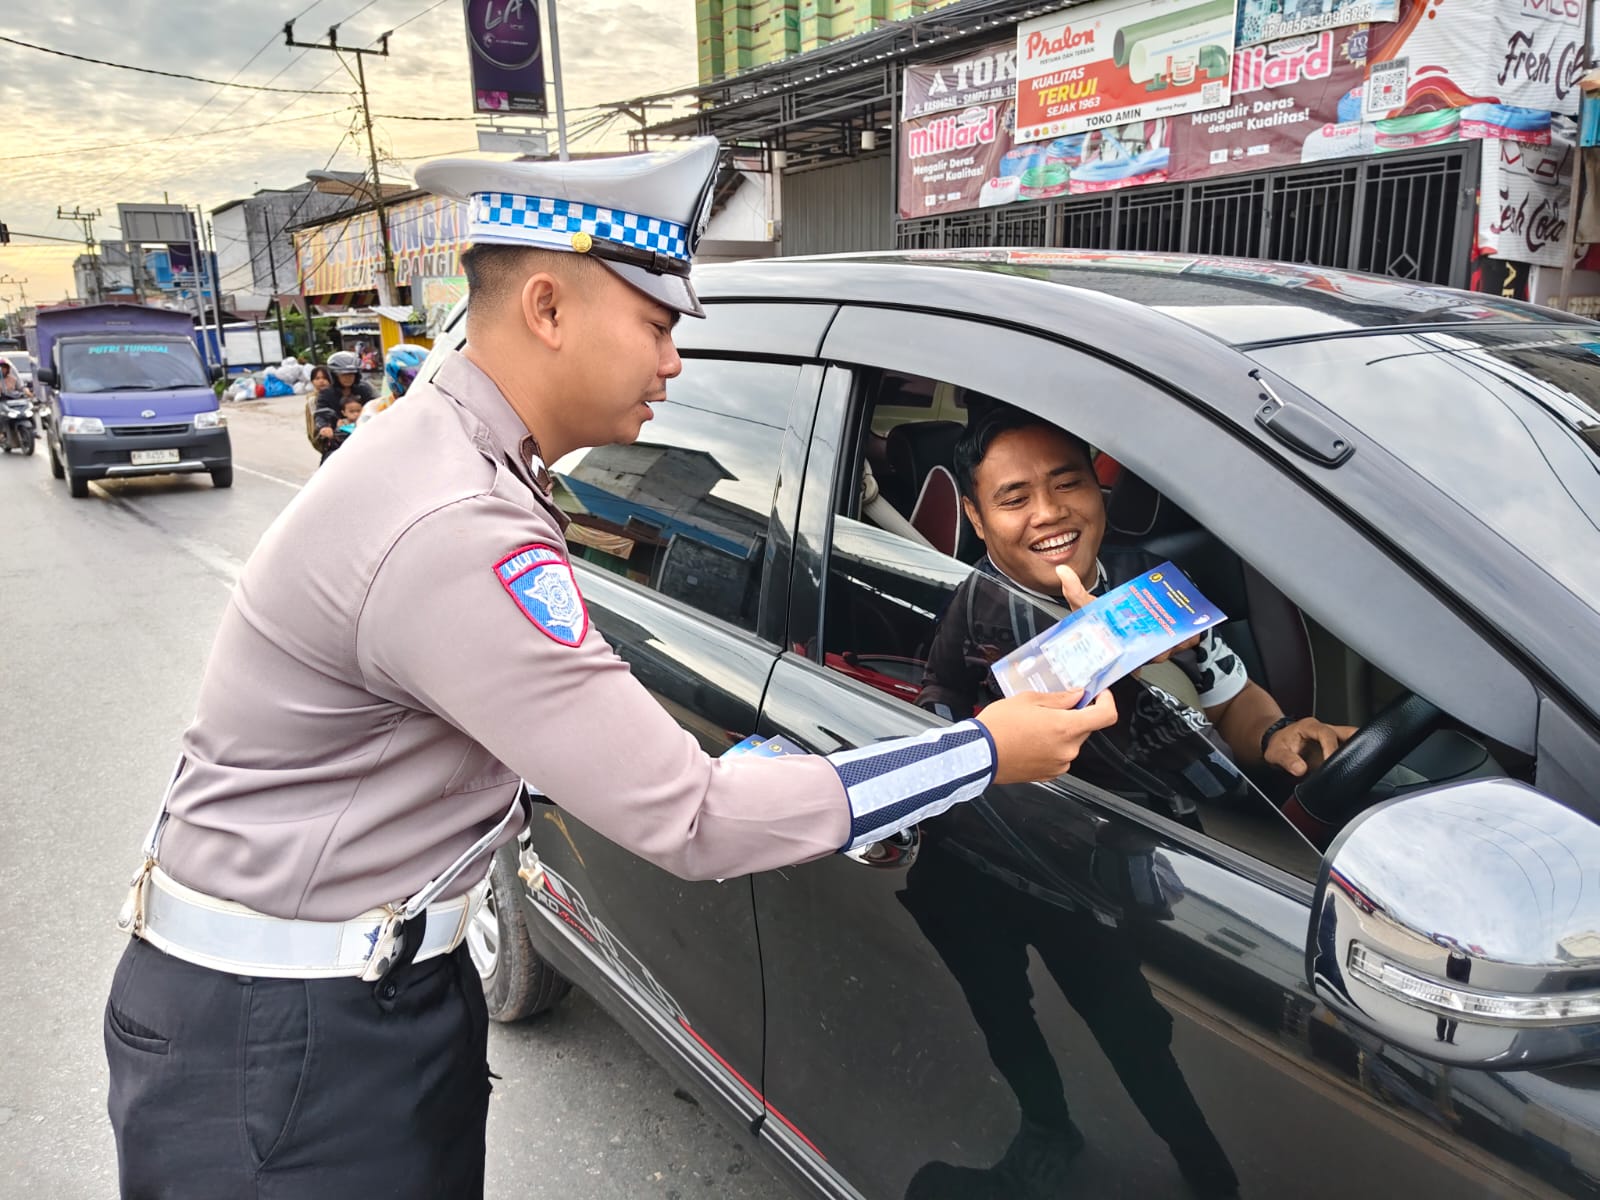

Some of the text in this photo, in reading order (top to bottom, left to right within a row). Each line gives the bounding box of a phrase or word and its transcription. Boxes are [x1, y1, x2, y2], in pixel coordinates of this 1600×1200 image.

[1025, 24, 1095, 60] Pralon
[1497, 30, 1556, 86] Fresh
[1031, 67, 1085, 91] KUALITAS
[1038, 77, 1098, 107] TERUJI
[1046, 96, 1101, 117] SEJAK 1963
[1086, 108, 1142, 128] TOKO AMIN
[1191, 97, 1295, 126] Mengalir Deras
[908, 106, 996, 160] milliard
[1208, 107, 1311, 134] dengan Kualitas!
[913, 156, 975, 176] Mengalir Deras
[945, 165, 985, 181] Kualitas!
[397, 250, 454, 284] PANGI
[89, 344, 168, 354] PUTRI TUNGGAL
